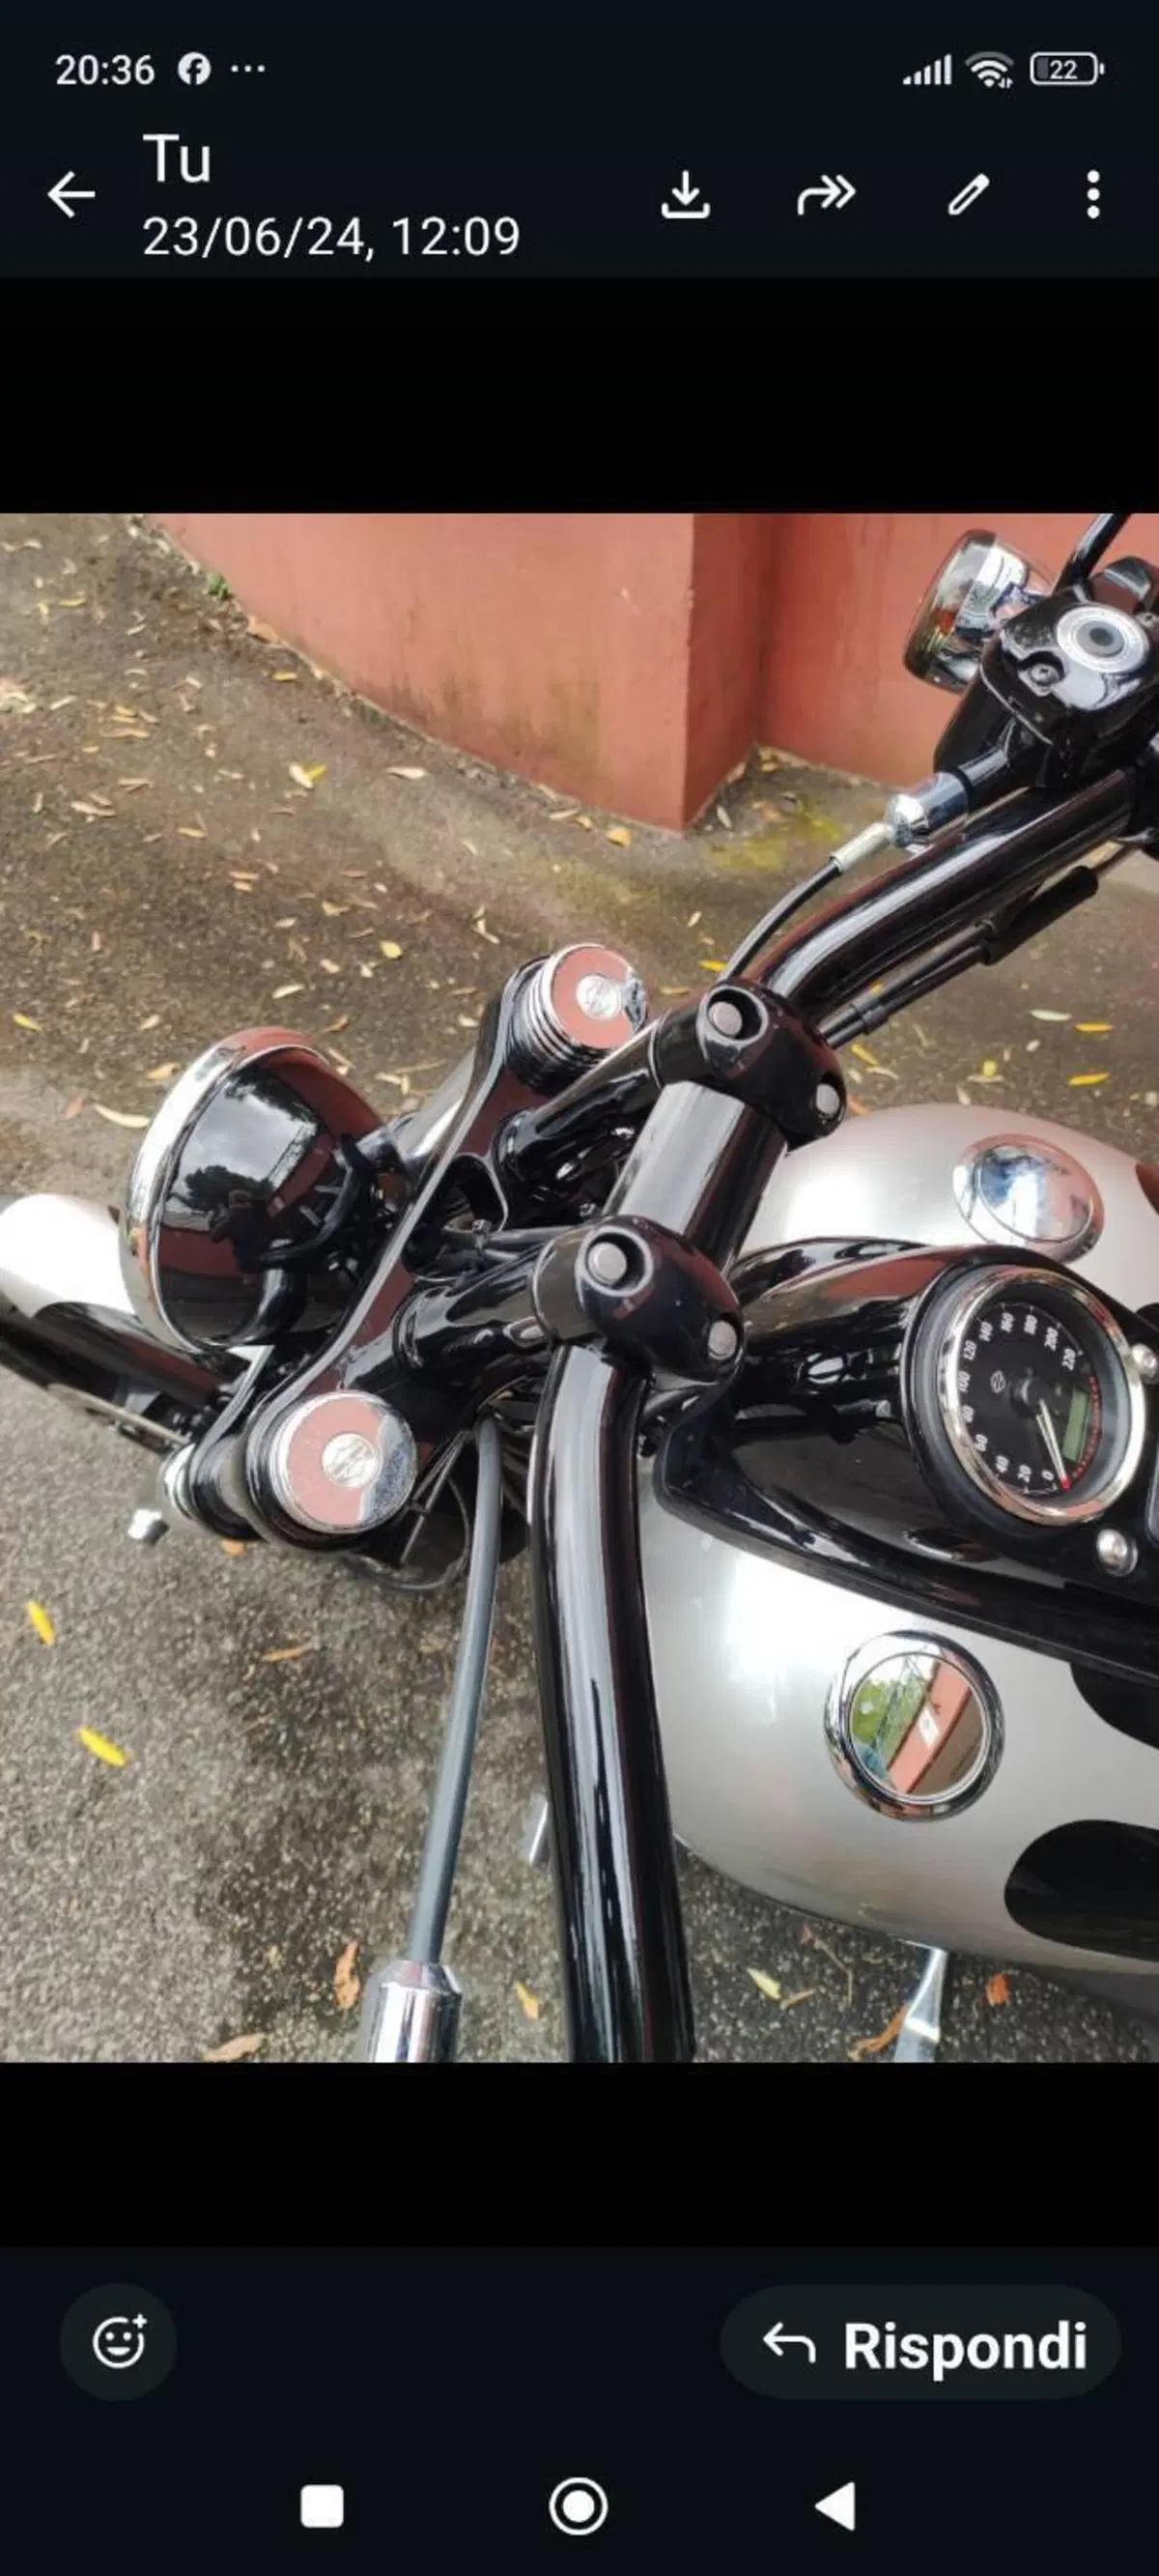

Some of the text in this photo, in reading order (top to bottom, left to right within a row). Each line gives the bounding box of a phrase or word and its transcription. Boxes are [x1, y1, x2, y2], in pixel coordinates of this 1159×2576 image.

[978, 1321, 994, 1343] 140
[1044, 1327, 1060, 1351] 200
[963, 1339, 977, 1360] 120
[1061, 1348, 1077, 1371] 220
[957, 1370, 971, 1392] 100
[974, 1433, 988, 1452] 60
[995, 1454, 1010, 1474] 40
[1017, 1464, 1032, 1483] 20
[1041, 1469, 1055, 1481] 0
